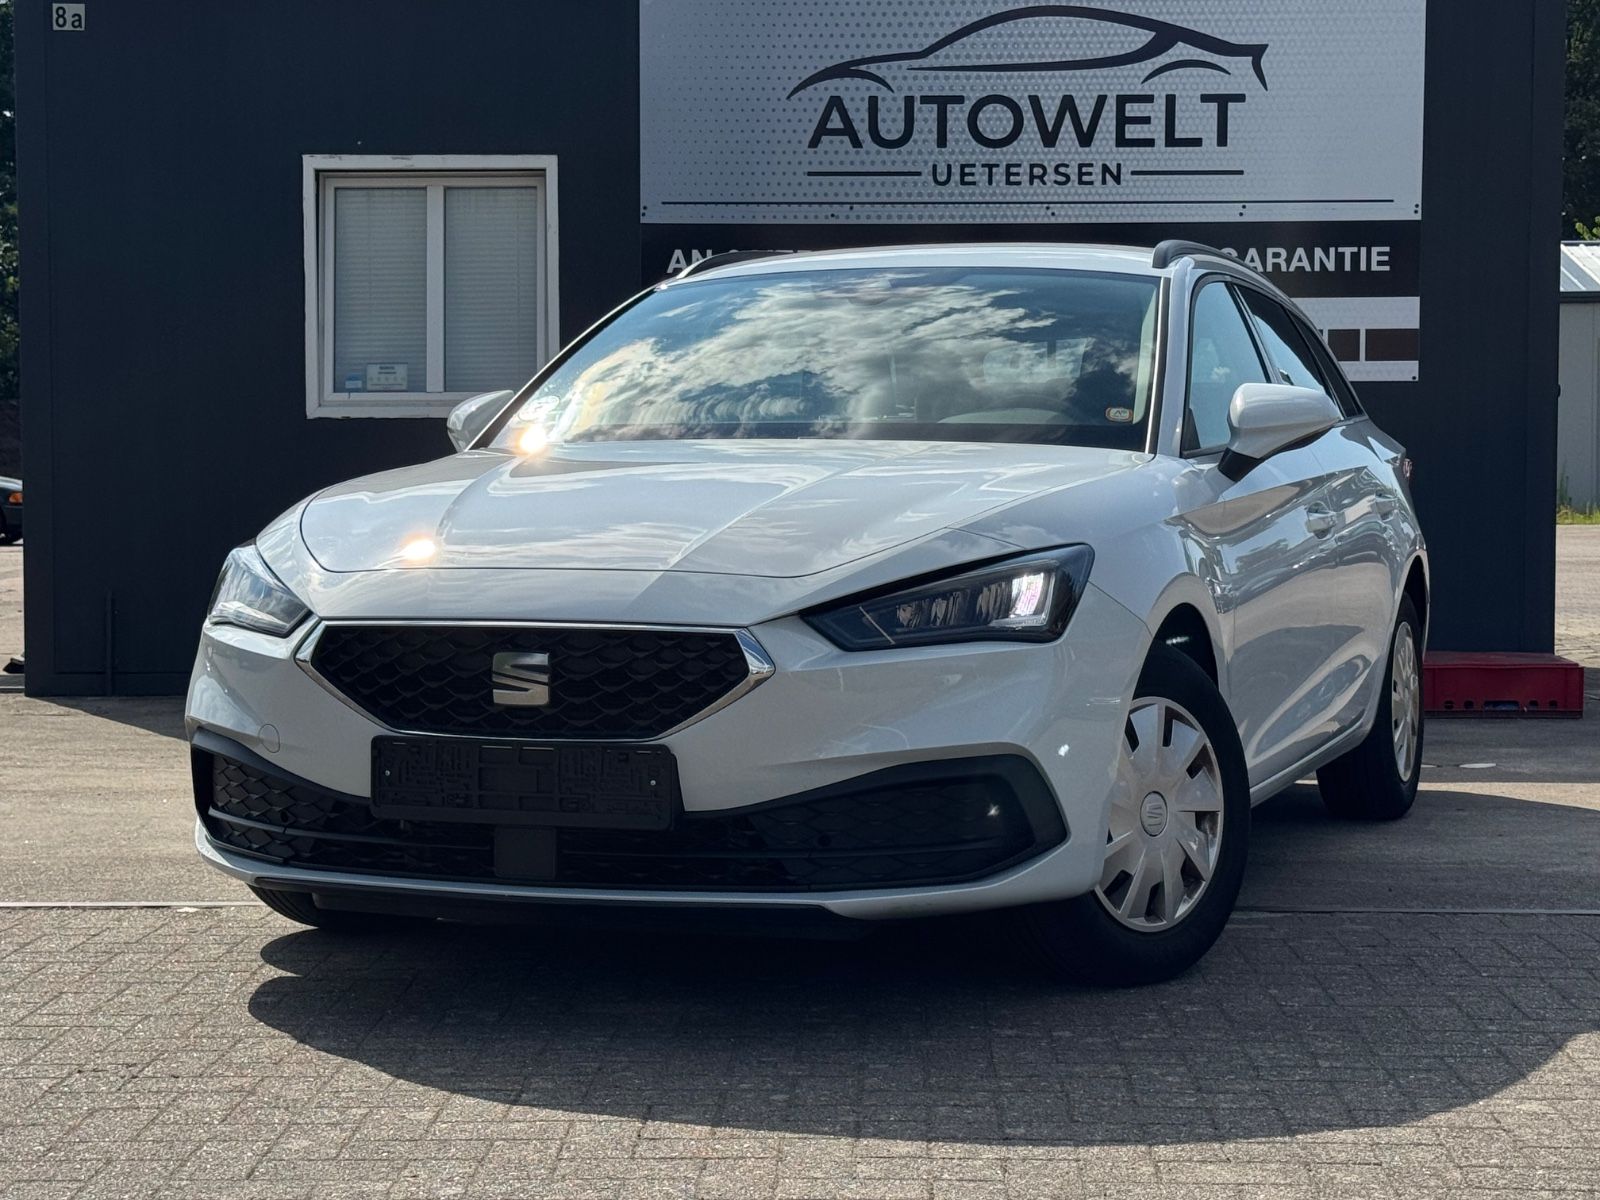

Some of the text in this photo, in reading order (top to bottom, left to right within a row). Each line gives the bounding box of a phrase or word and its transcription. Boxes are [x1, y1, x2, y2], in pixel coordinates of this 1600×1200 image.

[55, 6, 83, 29] 8a
[807, 94, 1246, 149] AUTOWELT
[932, 162, 1122, 186] UETERSEN
